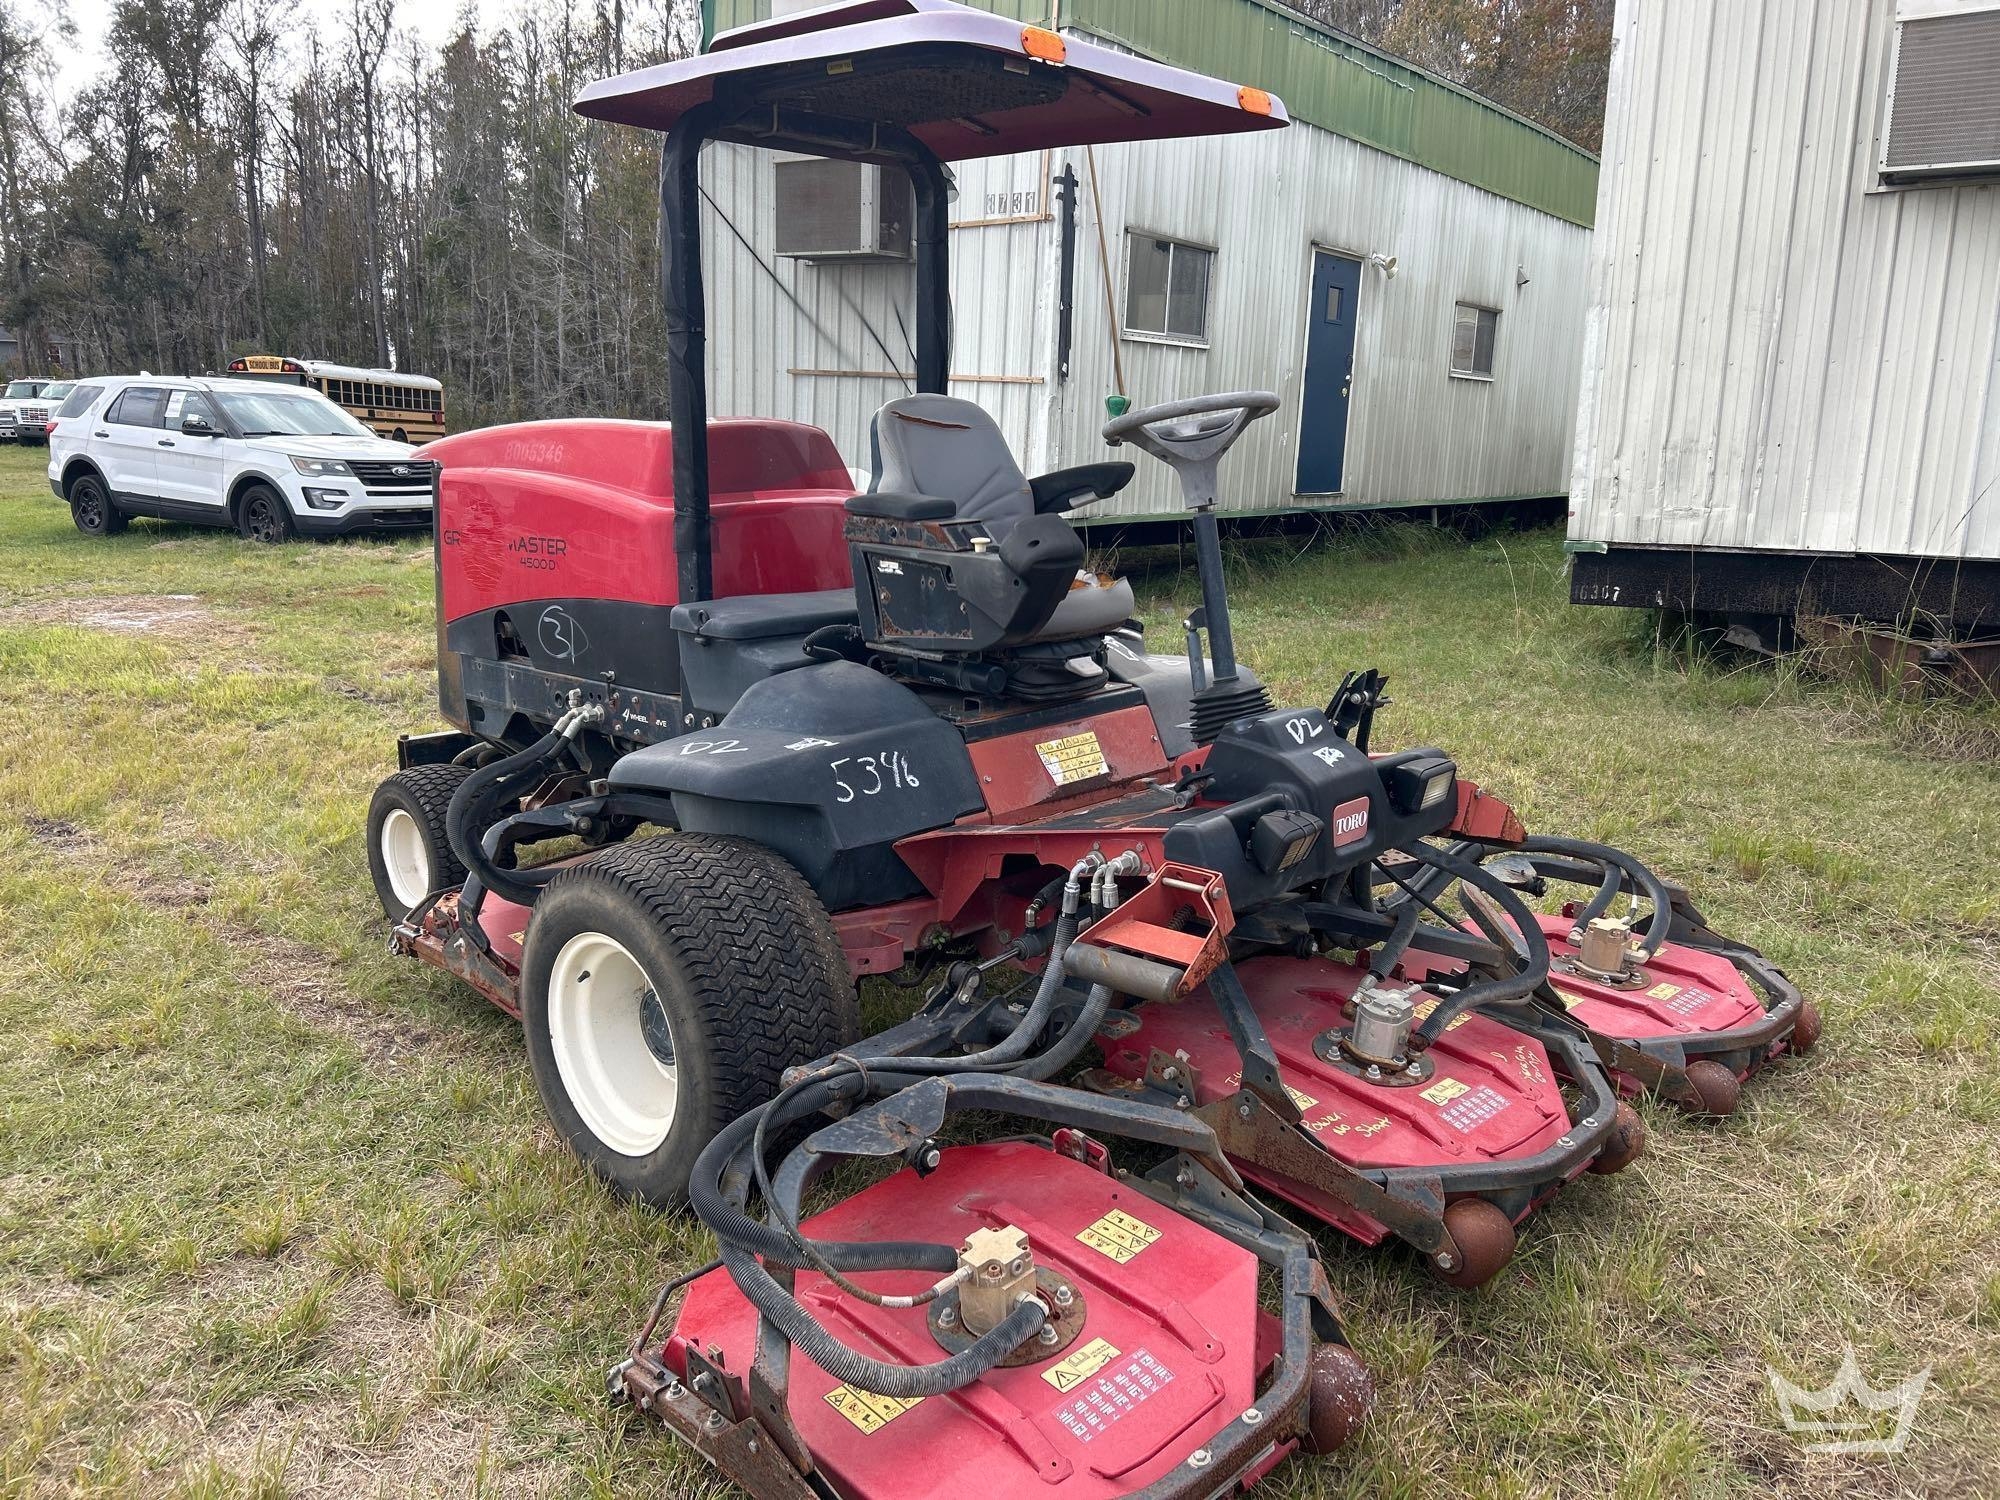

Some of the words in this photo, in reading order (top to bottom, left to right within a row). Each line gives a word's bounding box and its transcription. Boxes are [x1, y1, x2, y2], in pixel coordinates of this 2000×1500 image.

[249, 360, 268, 369] SCHOOL
[270, 361, 280, 370] BUS
[622, 708, 630, 722] 4
[831, 751, 920, 803] 5346
[1336, 810, 1367, 835] TORO
